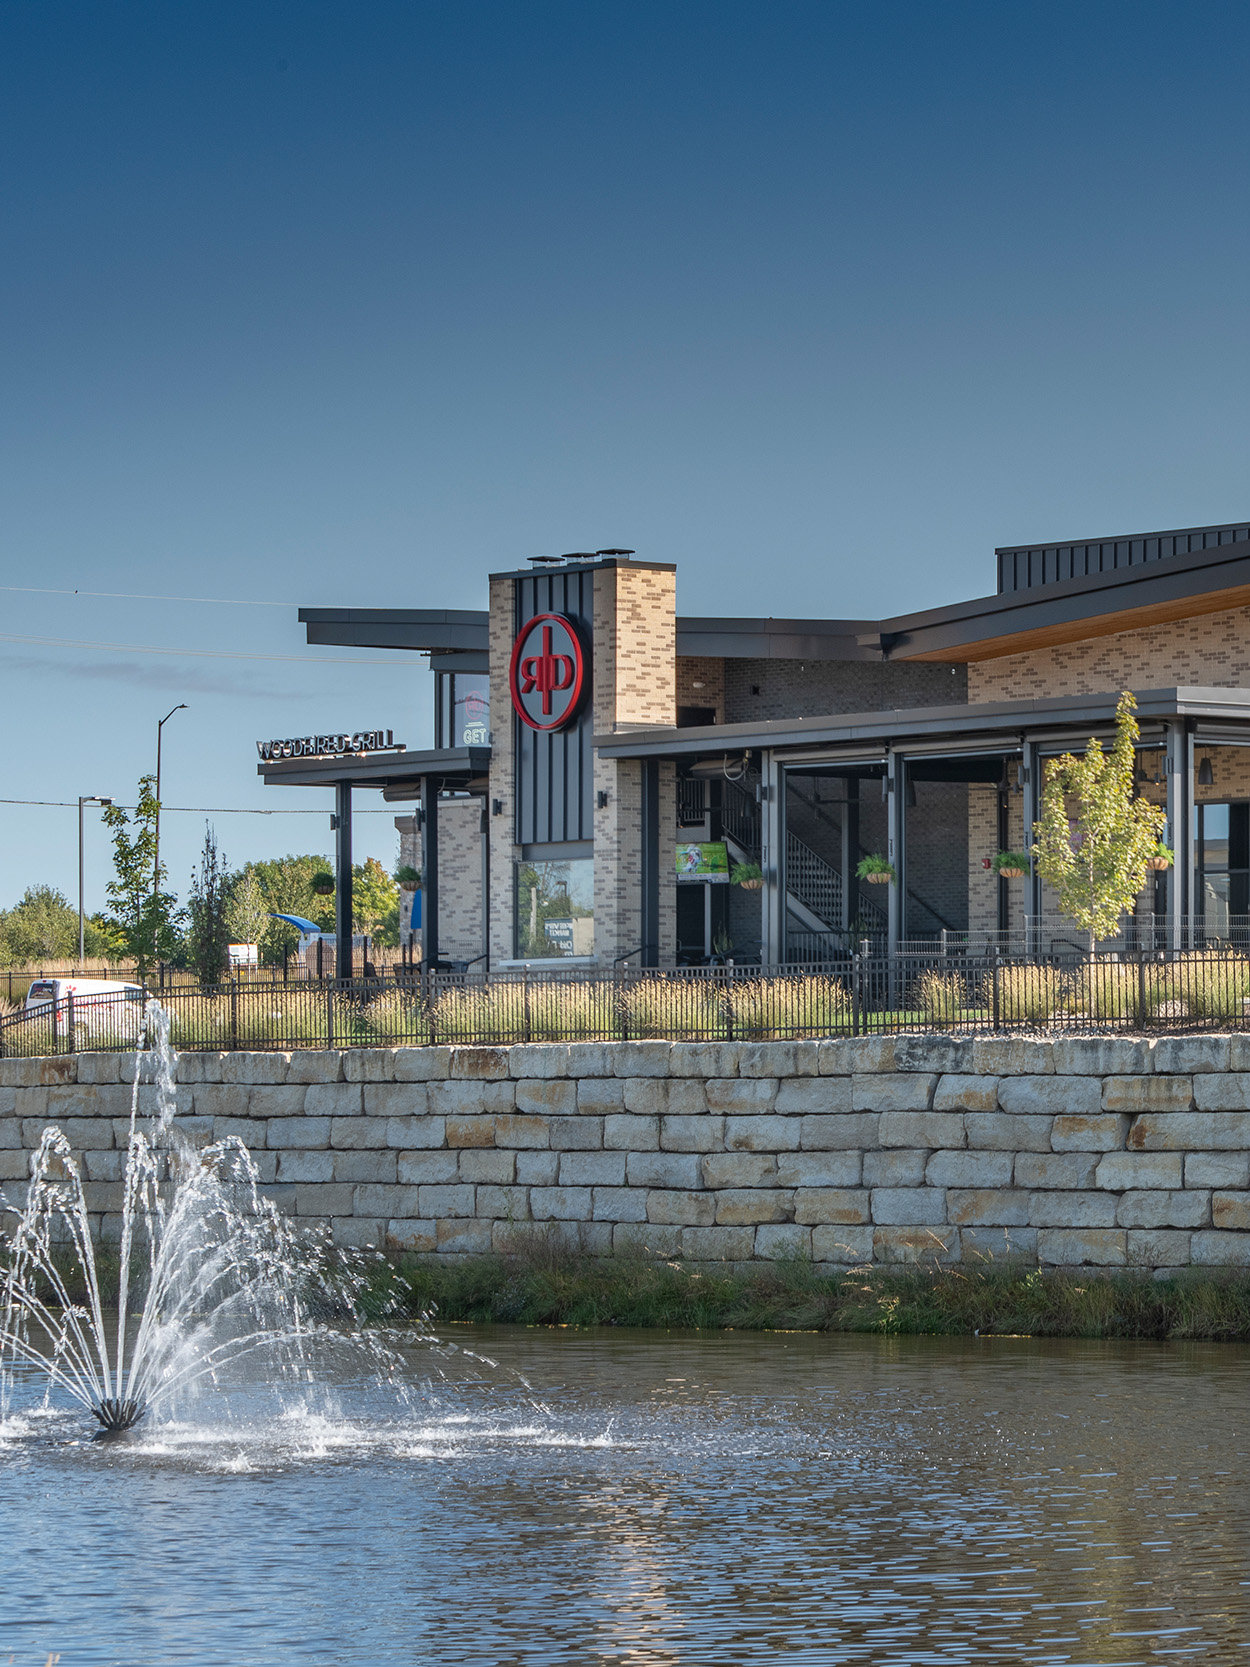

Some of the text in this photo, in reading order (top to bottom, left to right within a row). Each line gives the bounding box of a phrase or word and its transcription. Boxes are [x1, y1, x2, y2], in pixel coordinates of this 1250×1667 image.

[256, 729, 395, 760] WOODFIRED GRILL
[463, 728, 487, 745] GET
